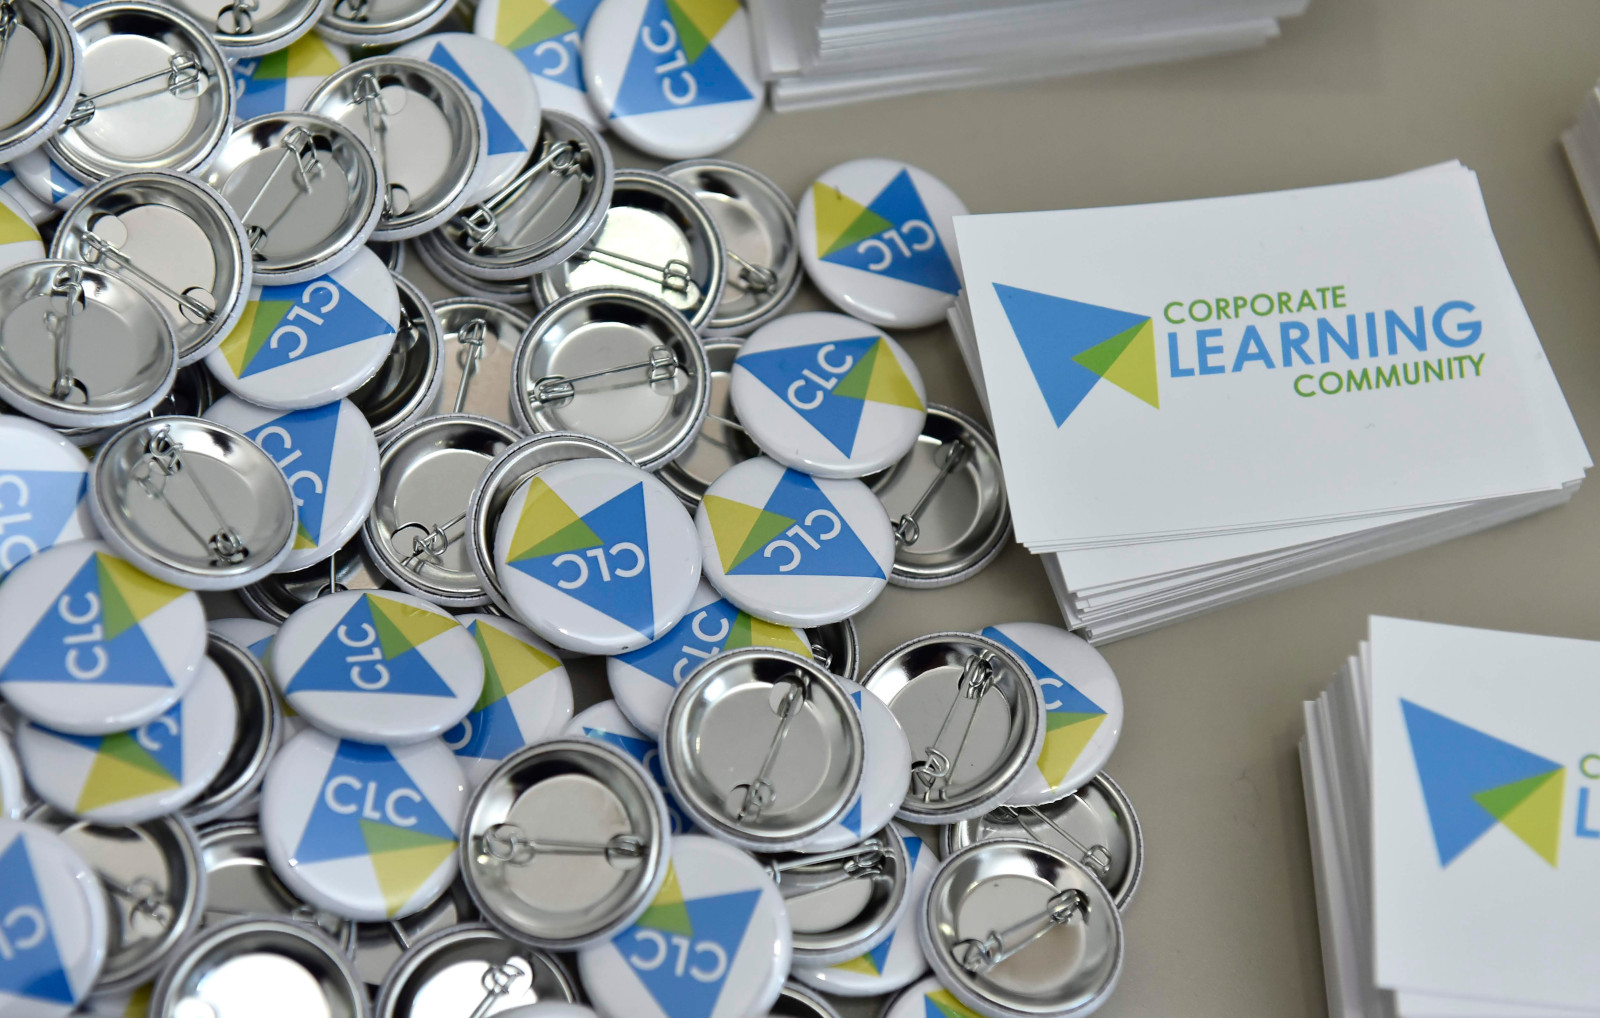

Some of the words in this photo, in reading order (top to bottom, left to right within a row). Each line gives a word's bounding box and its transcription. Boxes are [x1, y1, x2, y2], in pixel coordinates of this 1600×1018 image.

[642, 20, 698, 105] CLC
[858, 219, 935, 271] CLC
[269, 280, 340, 359] CLC
[1163, 285, 1347, 324] CORPORATE
[1167, 300, 1482, 378] LEARNING
[787, 344, 853, 410] CLC
[1293, 353, 1486, 397] COMMUNITY
[552, 541, 645, 590] CLC
[763, 509, 842, 572] CLC
[58, 591, 108, 680] CLC
[337, 623, 390, 690] CLC
[324, 775, 422, 827] CLC
[630, 931, 728, 983] CLC
